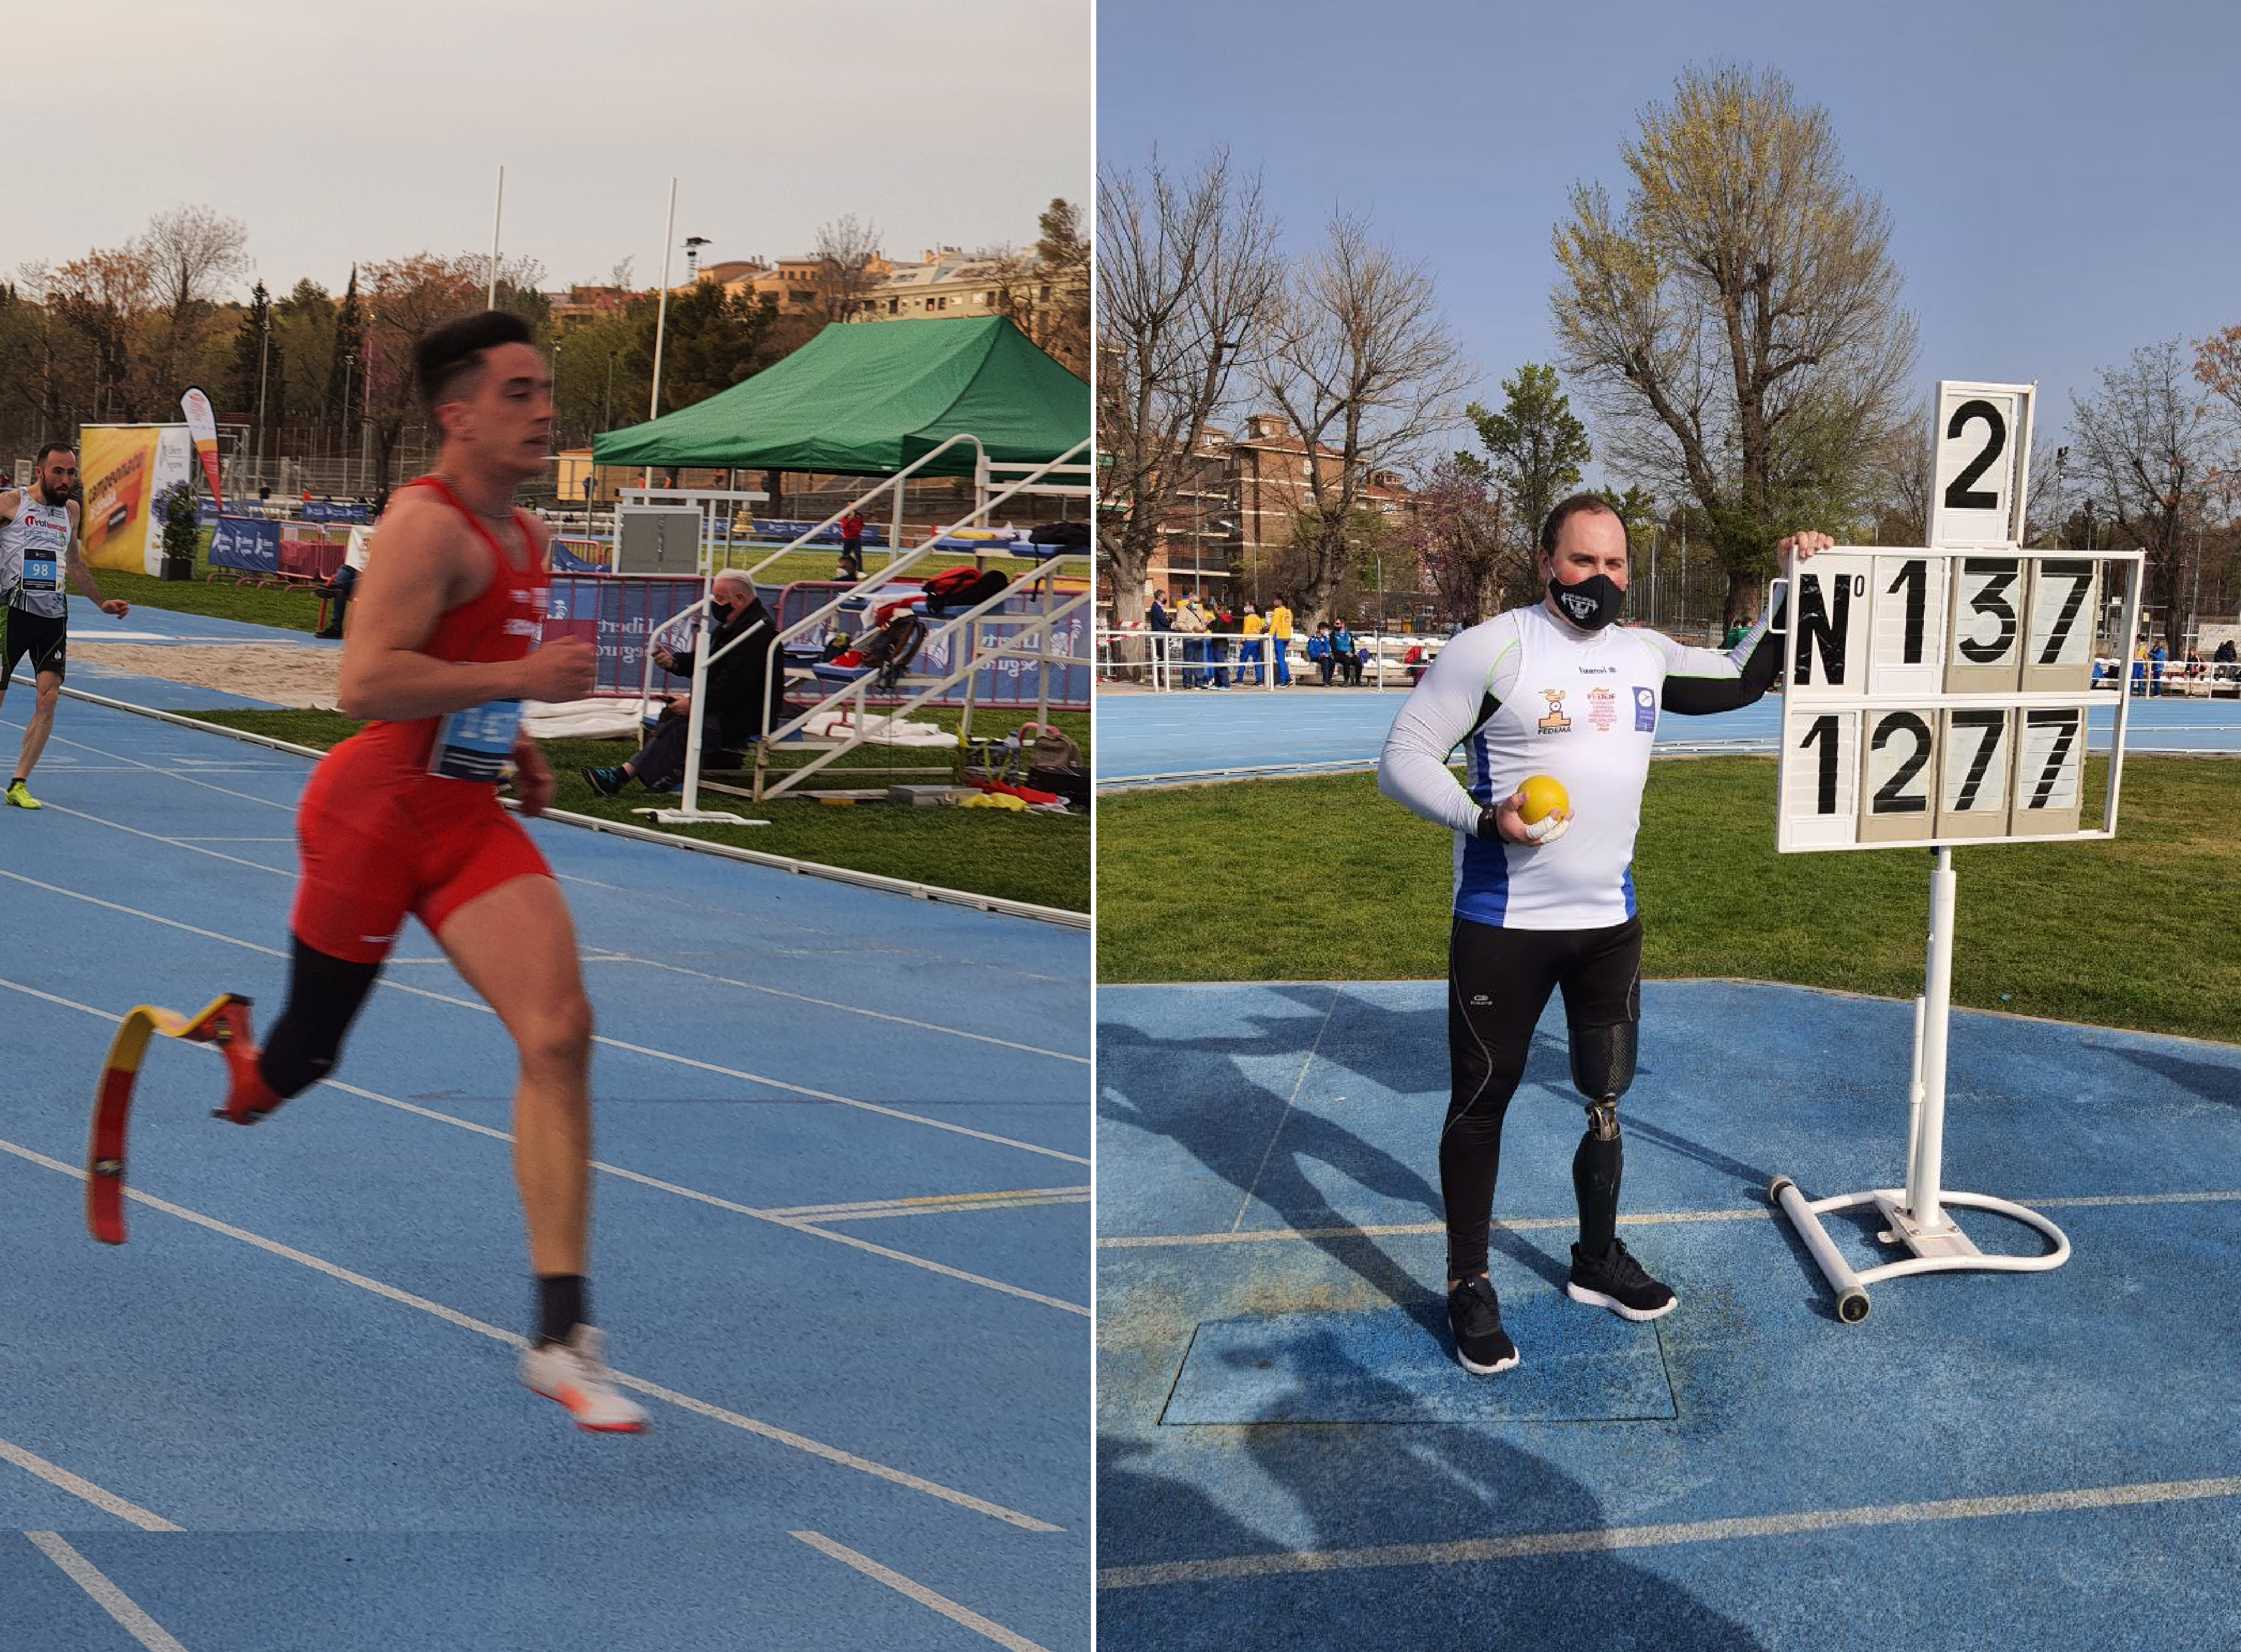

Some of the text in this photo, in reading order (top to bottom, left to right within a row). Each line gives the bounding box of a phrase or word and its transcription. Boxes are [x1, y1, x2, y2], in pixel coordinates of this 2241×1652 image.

[1944, 399, 2006, 510] 2
[32, 564, 49, 577] 98
[1886, 558, 2094, 665] 137
[1799, 709, 2079, 816] 1277
